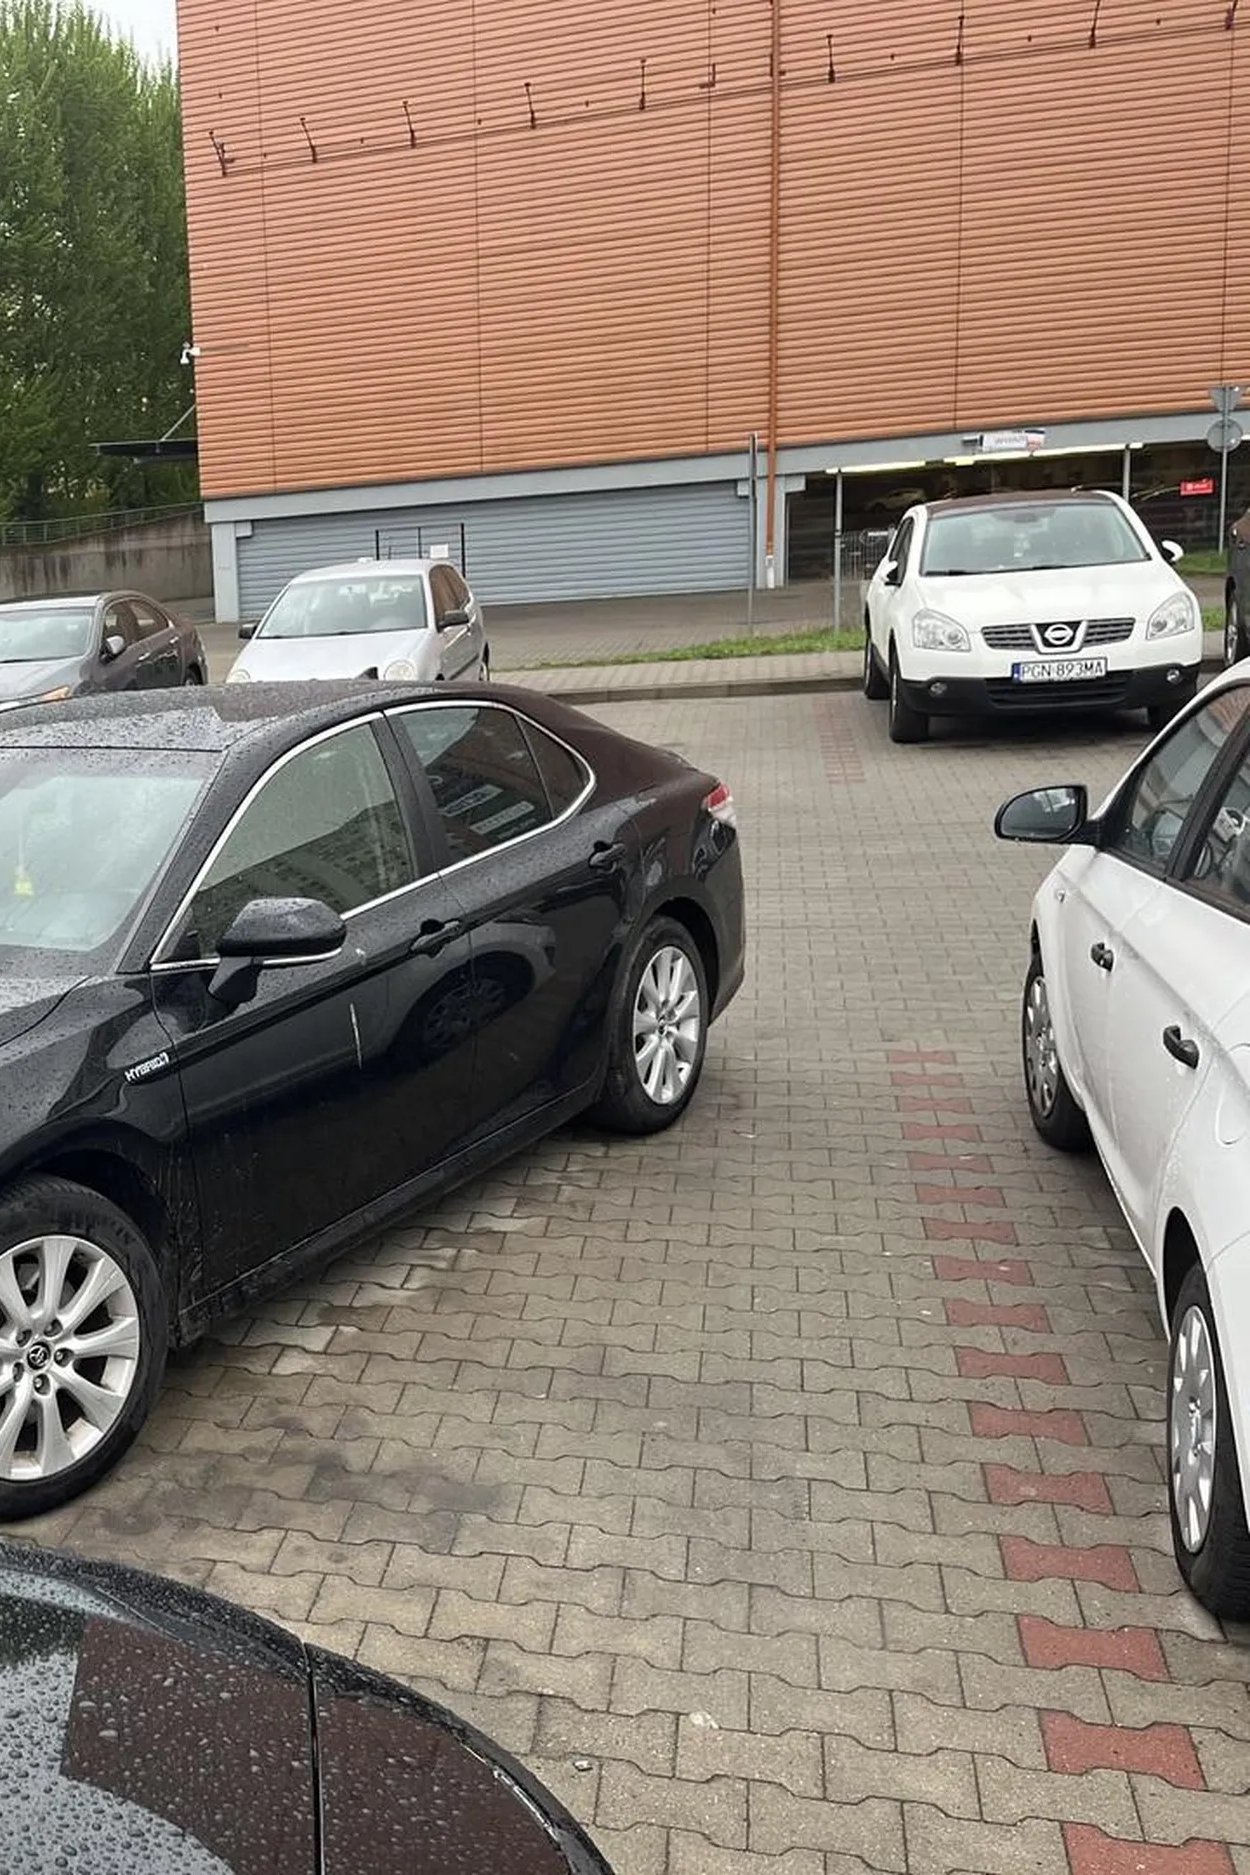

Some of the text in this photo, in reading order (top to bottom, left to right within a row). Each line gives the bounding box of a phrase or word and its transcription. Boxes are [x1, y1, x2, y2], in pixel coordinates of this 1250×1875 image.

[1021, 660, 1103, 679] PGN 893MA
[124, 1055, 162, 1082] HYBRID
